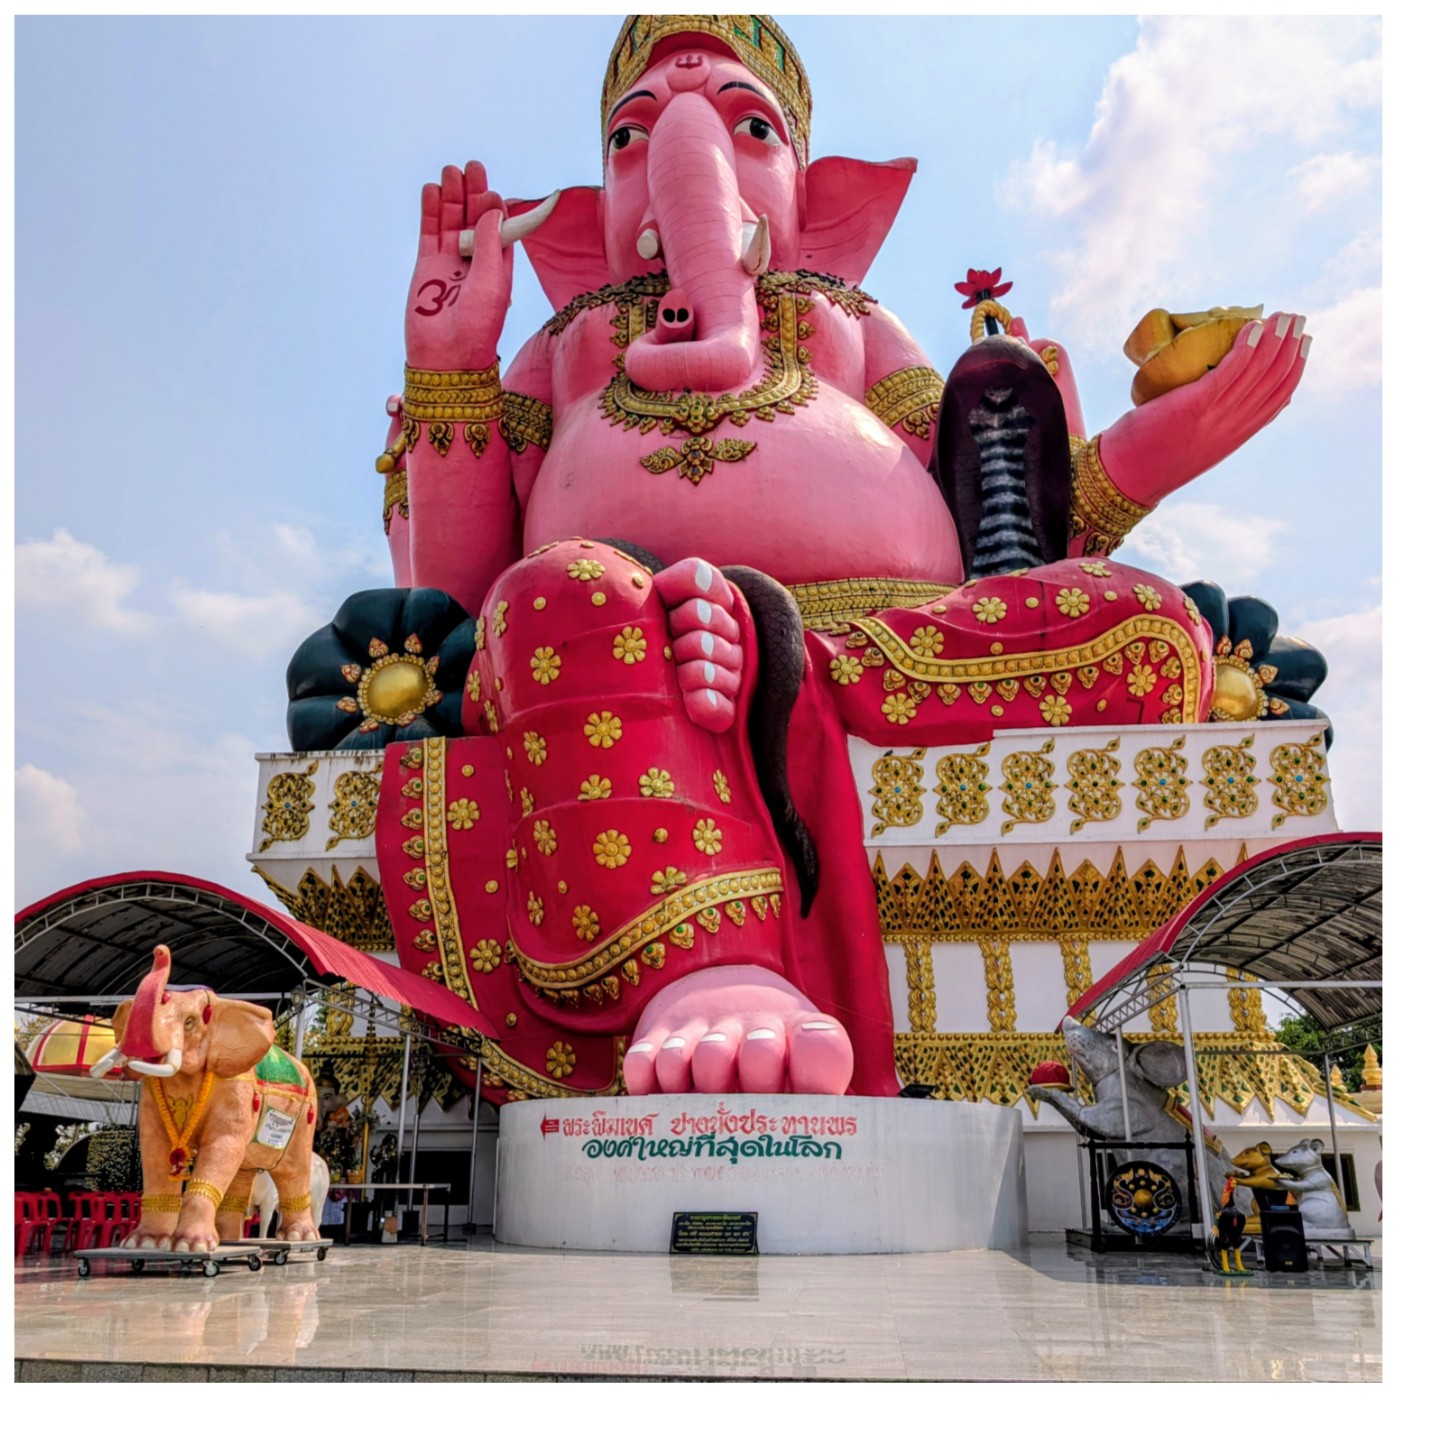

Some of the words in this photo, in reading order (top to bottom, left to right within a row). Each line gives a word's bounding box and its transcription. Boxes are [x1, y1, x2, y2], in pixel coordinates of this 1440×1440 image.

[582, 1132, 843, 1165] องค์ใหญ่ที่สุดในโลก
